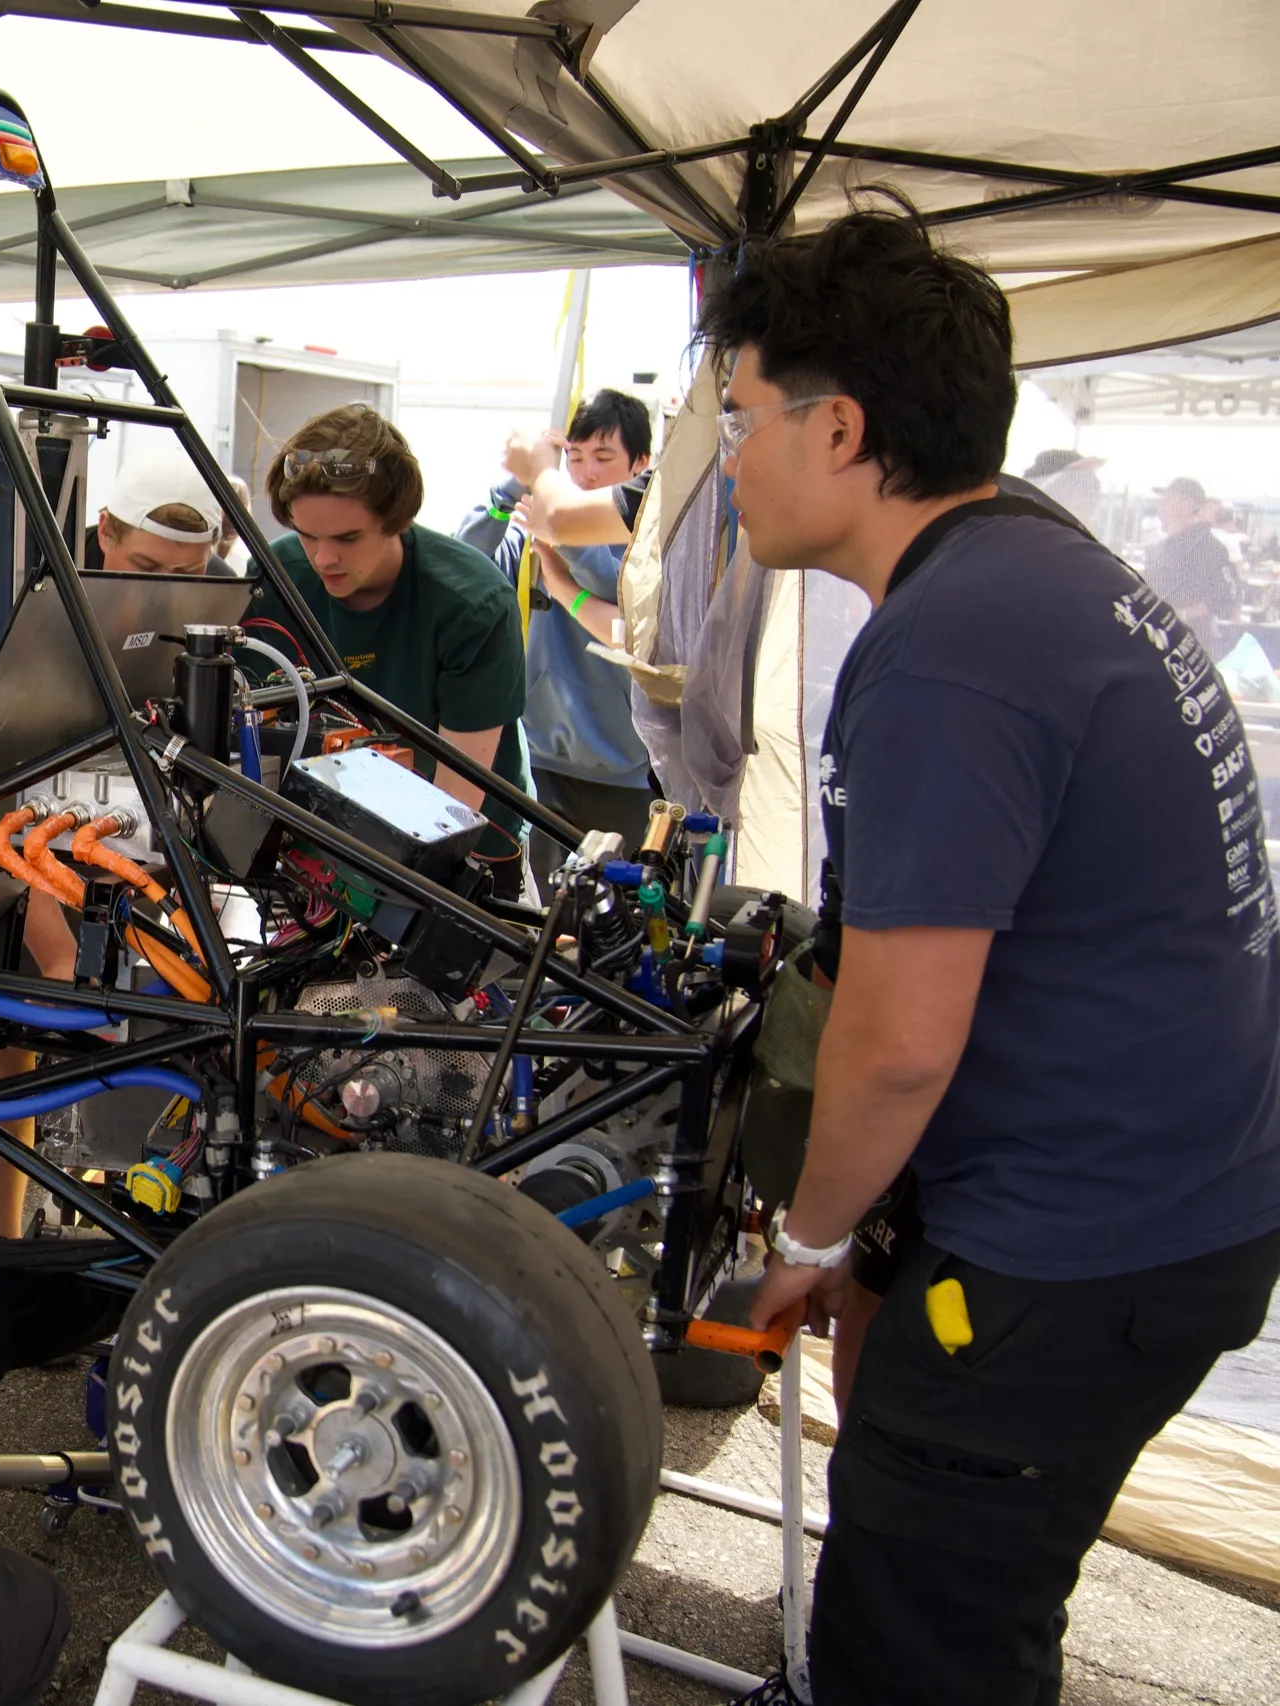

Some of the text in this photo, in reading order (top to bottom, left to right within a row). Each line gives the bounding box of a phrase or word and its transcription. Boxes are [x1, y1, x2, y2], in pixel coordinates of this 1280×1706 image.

[128, 634, 149, 647] MSD
[1211, 741, 1245, 790] SKF
[1225, 838, 1250, 863] GMN
[1227, 863, 1249, 884] NAV
[114, 1288, 179, 1564] Hoosier
[495, 1366, 584, 1665] Hoosier
